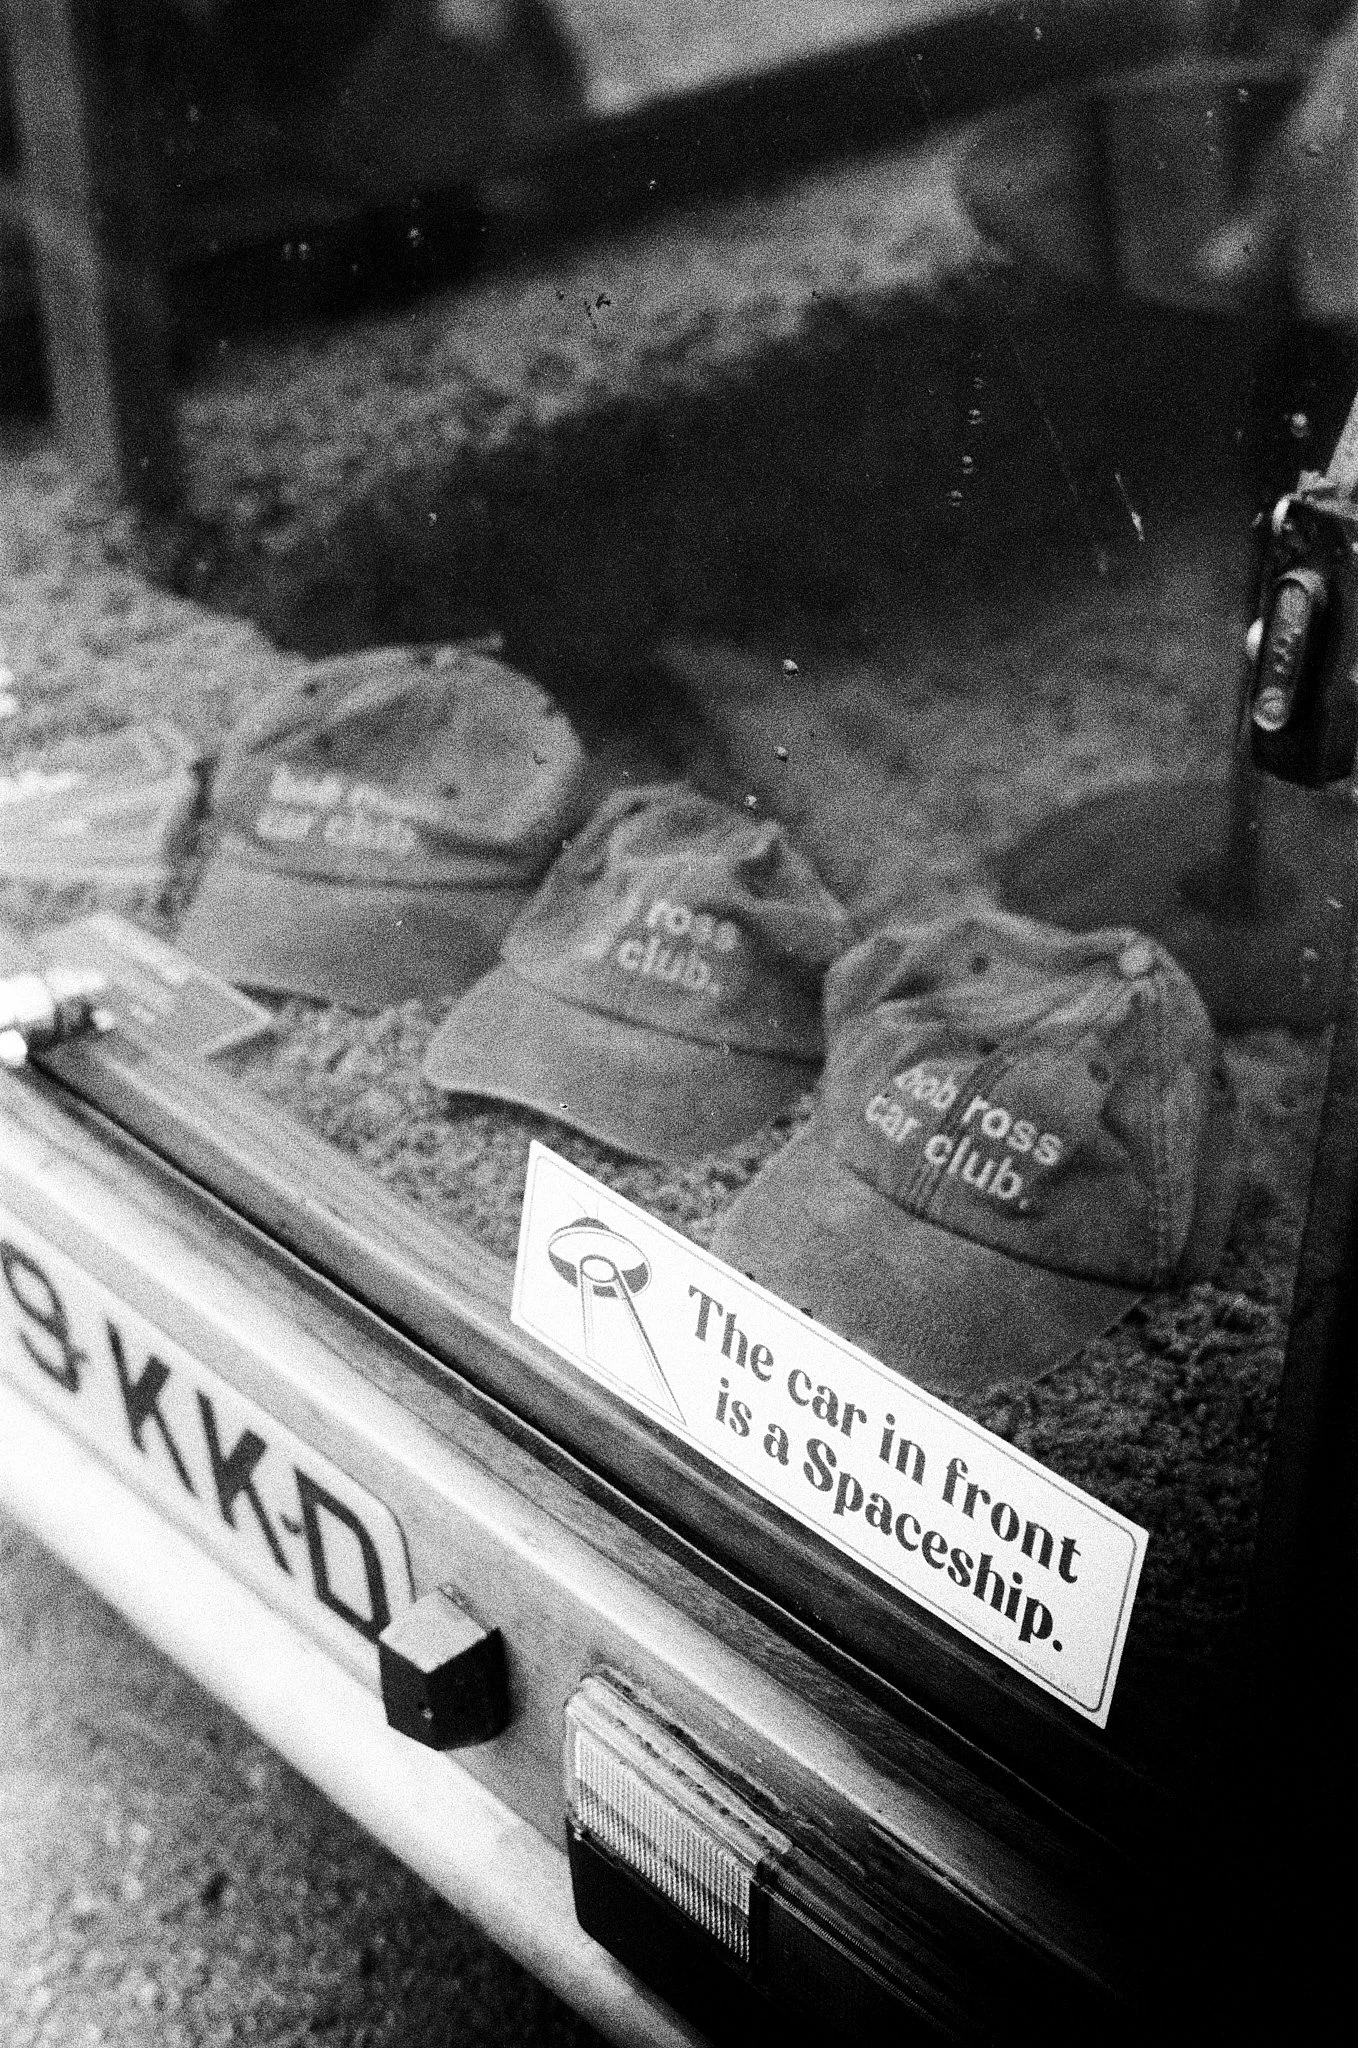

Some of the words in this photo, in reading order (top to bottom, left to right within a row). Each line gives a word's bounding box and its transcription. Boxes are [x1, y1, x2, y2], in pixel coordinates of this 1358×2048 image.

[865, 1095, 920, 1142] car
[924, 1135, 1028, 1209] club.
[962, 1095, 1063, 1166] ross
[688, 1285, 774, 1382] The
[787, 1369, 867, 1438] car
[879, 1413, 926, 1486] in
[942, 1457, 1081, 1584] front
[715, 1376, 752, 1437] is
[763, 1423, 789, 1466] a
[803, 1438, 1063, 1652] Spaceship.
